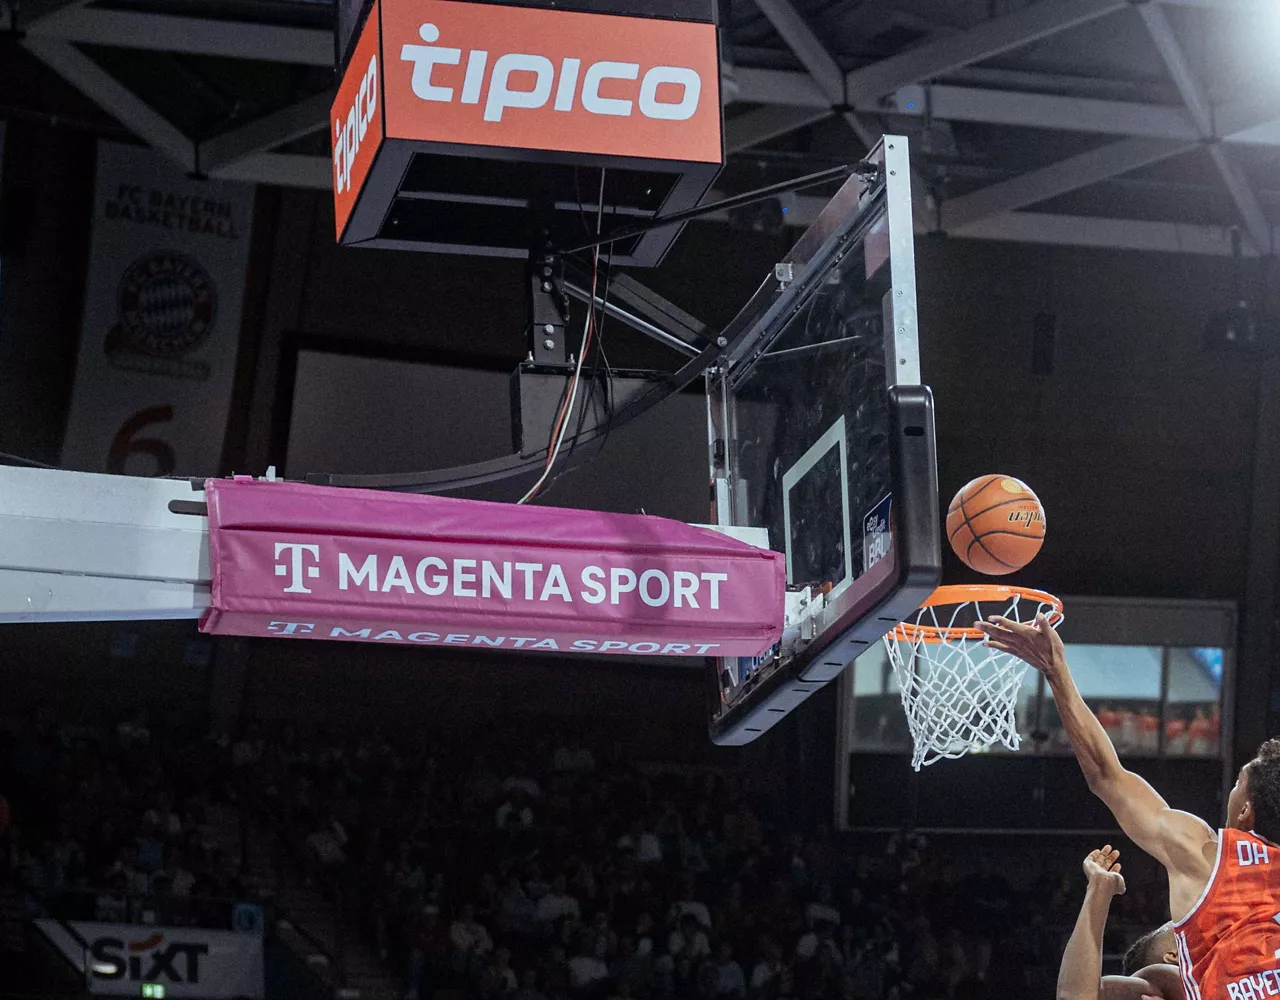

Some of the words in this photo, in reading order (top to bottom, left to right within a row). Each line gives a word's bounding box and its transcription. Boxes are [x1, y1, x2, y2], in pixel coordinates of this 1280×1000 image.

[400, 22, 702, 122] tipico
[334, 54, 377, 195] tipico
[104, 201, 239, 240] BASKETBALL
[118, 184, 141, 201] FC
[148, 187, 232, 218] BAYERN
[338, 552, 572, 603] MAGENTA
[581, 565, 728, 610] SPORT
[329, 627, 560, 650] MAGENTA
[569, 639, 721, 655] SPORT
